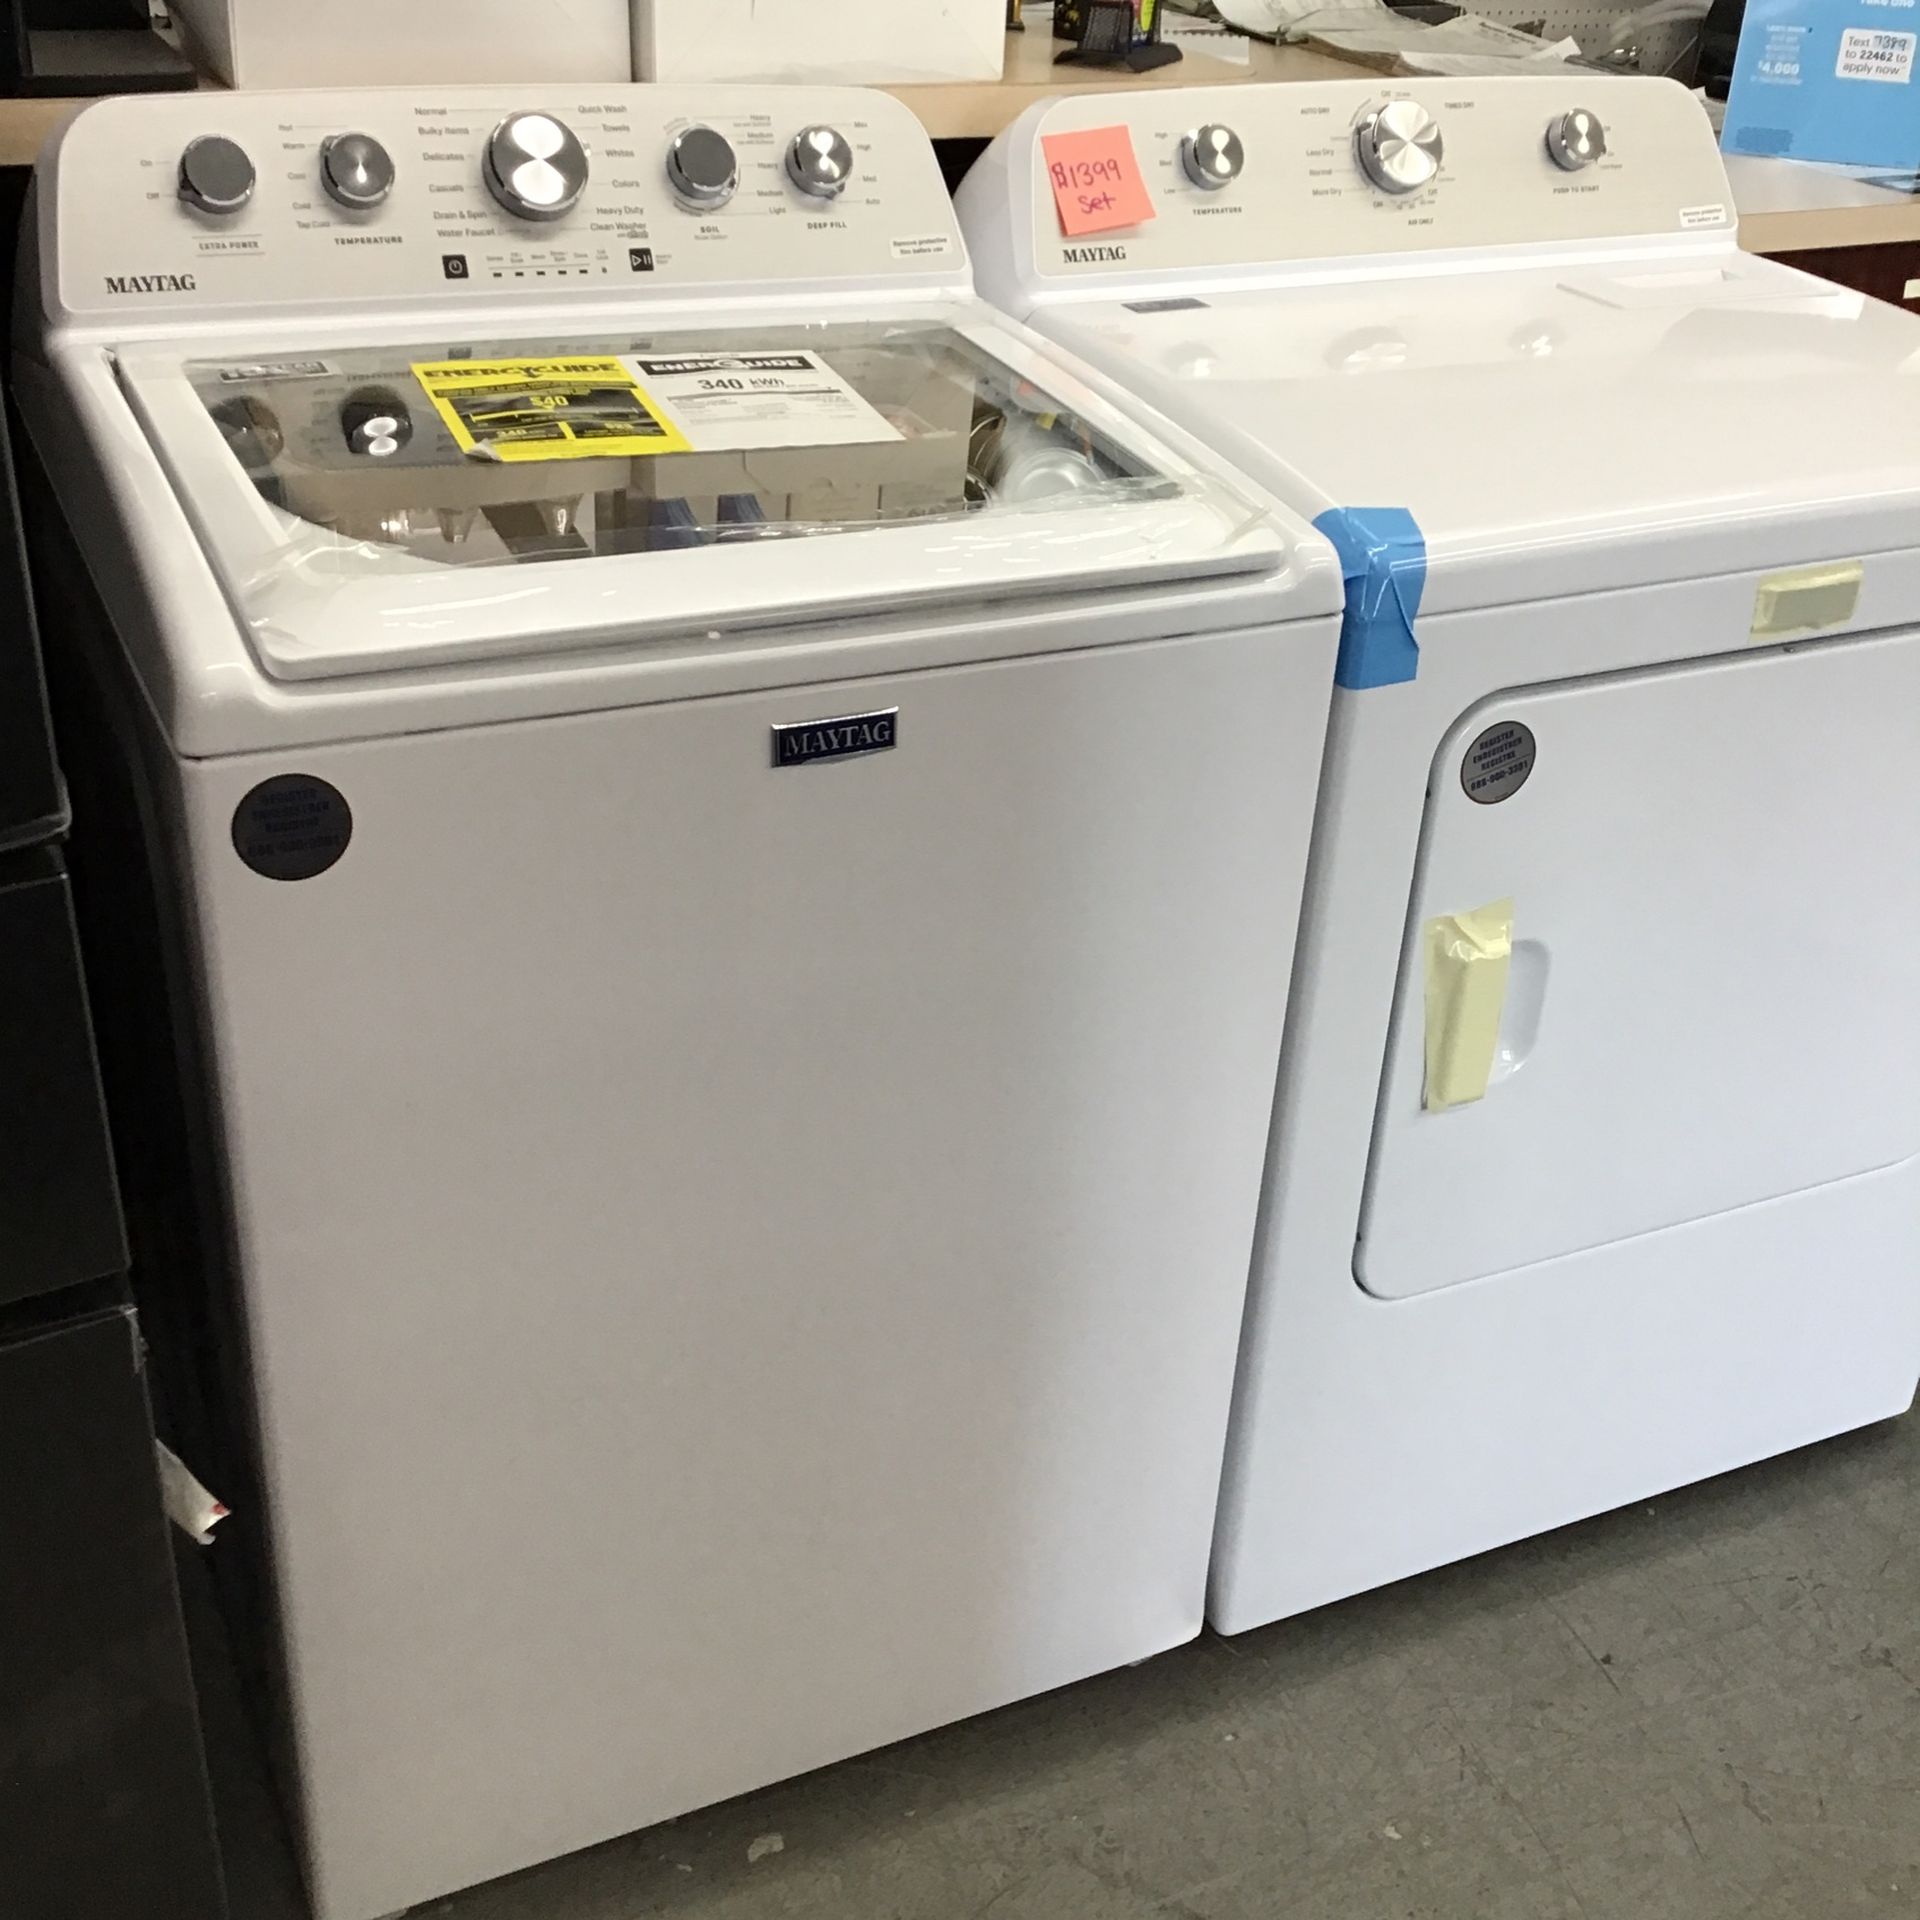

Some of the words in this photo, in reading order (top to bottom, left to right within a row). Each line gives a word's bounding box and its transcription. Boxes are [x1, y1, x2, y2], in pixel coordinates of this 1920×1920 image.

[1849, 36, 1870, 47] Text
[1845, 50, 1857, 59] to
[1860, 50, 1893, 62] 22462
[1896, 54, 1908, 63] to
[1843, 63, 1873, 75] apply
[414, 107, 447, 116] Normal
[578, 105, 601, 114] Quick
[603, 105, 627, 113] Wash
[418, 127, 443, 137] Bulky
[445, 126, 470, 135] Items
[602, 124, 630, 132] Towels
[423, 152, 465, 161] Delicates
[605, 149, 635, 158] Whites
[429, 183, 464, 192] Casuals
[612, 180, 640, 188] Colors
[433, 211, 457, 220] Drain
[467, 210, 487, 221] Spin
[597, 207, 622, 216] Heavy
[624, 206, 644, 216] Duty
[769, 207, 786, 215] Light
[1192, 206, 1242, 215] TEMPERATURE
[590, 222, 614, 231] Clean
[616, 221, 647, 230] Washer
[437, 227, 463, 237] Water
[466, 227, 495, 237] Faucet
[334, 235, 403, 246] TEMPERATURE
[1063, 246, 1127, 264] MAYTAG
[104, 273, 197, 295] MAYTAG
[698, 378, 744, 390] 340
[749, 377, 785, 387] kWh
[784, 721, 892, 757] MAYTAG
